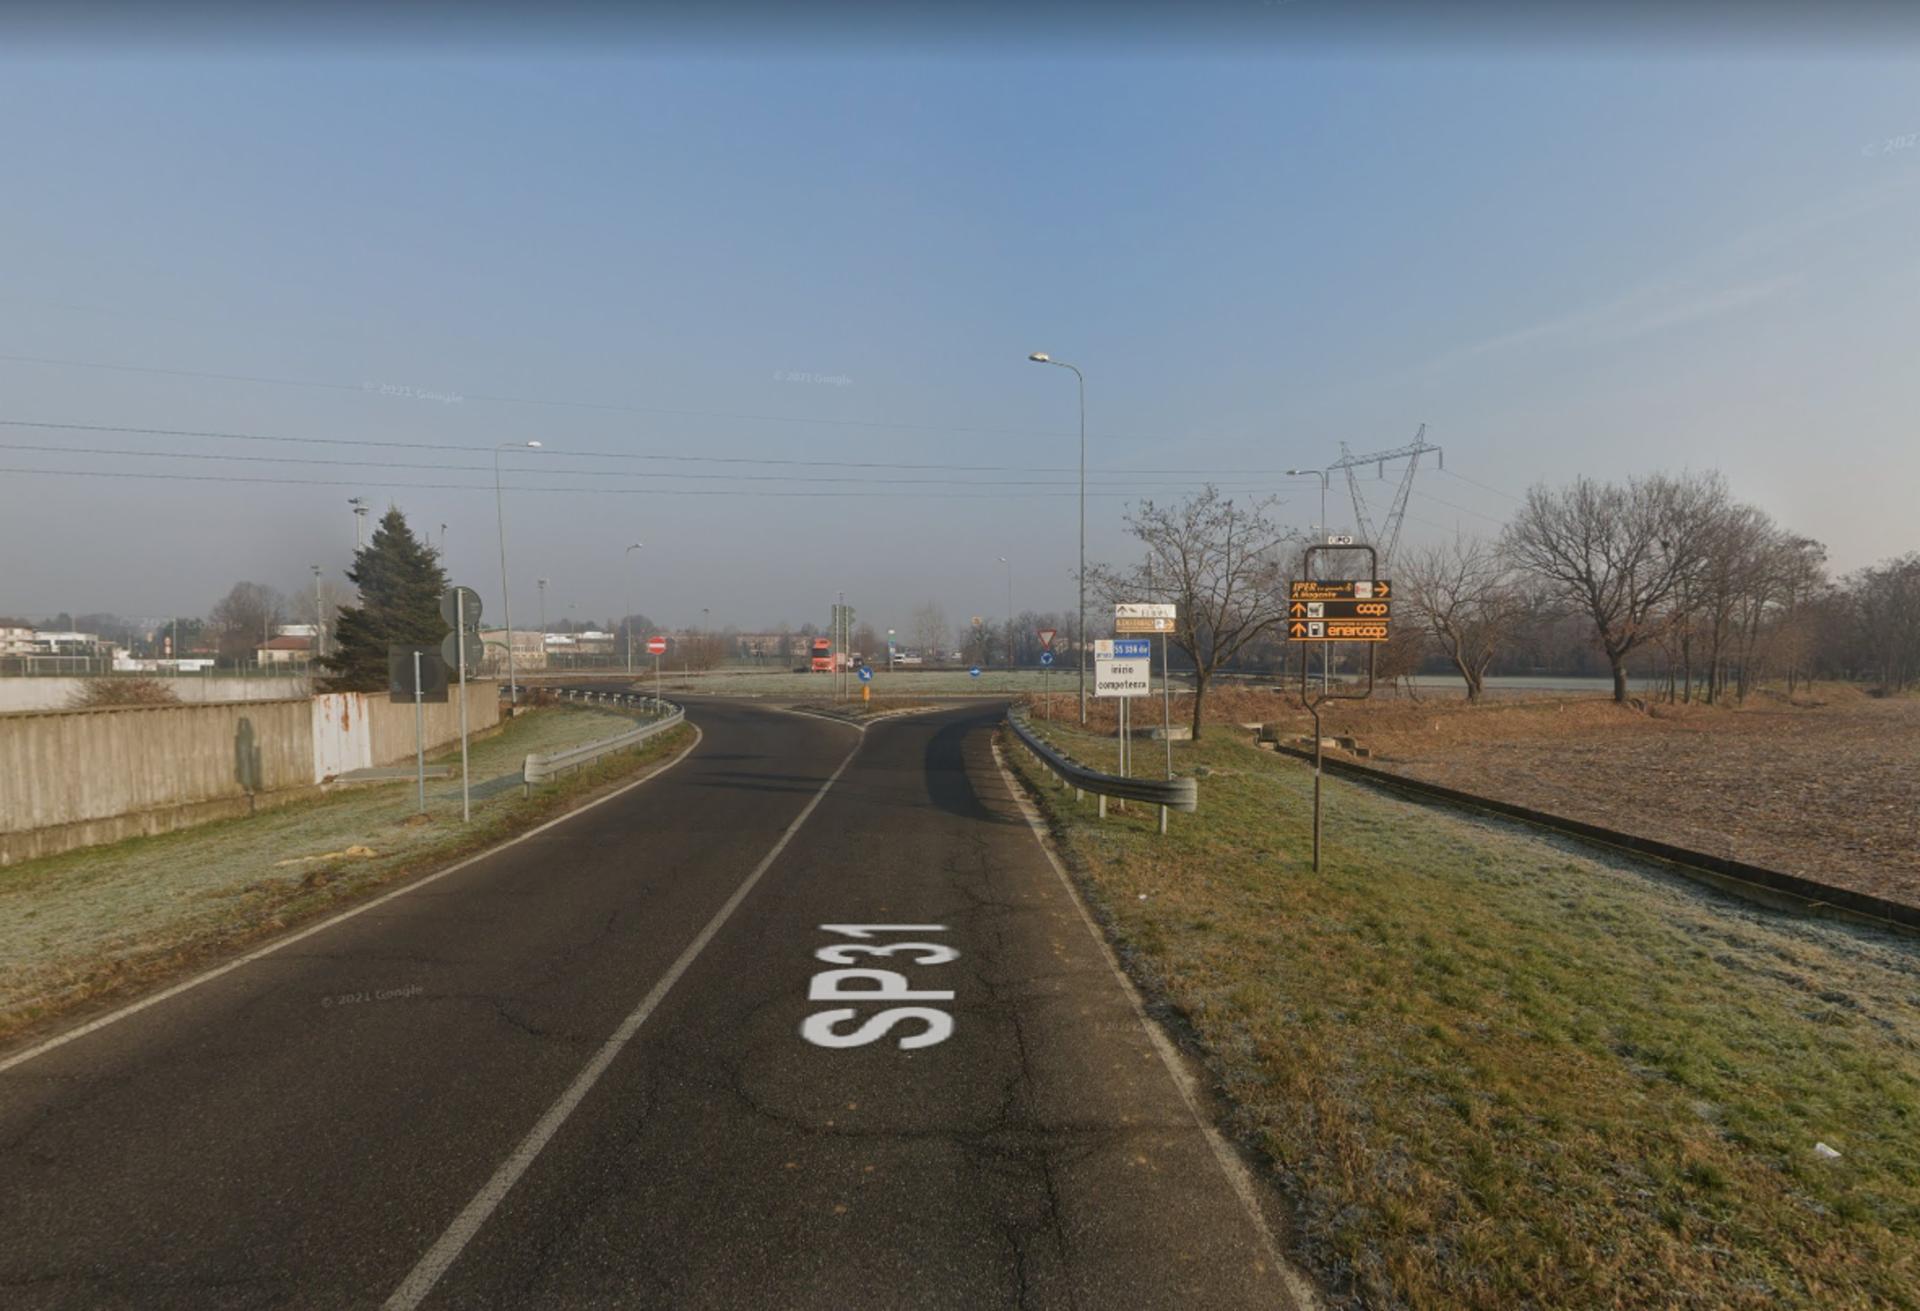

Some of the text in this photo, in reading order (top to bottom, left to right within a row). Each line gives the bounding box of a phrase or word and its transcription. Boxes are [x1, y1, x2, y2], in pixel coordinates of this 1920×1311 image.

[1356, 603, 1388, 616] coop
[1327, 626, 1388, 639] enercoop
[800, 923, 961, 1050] SP31
